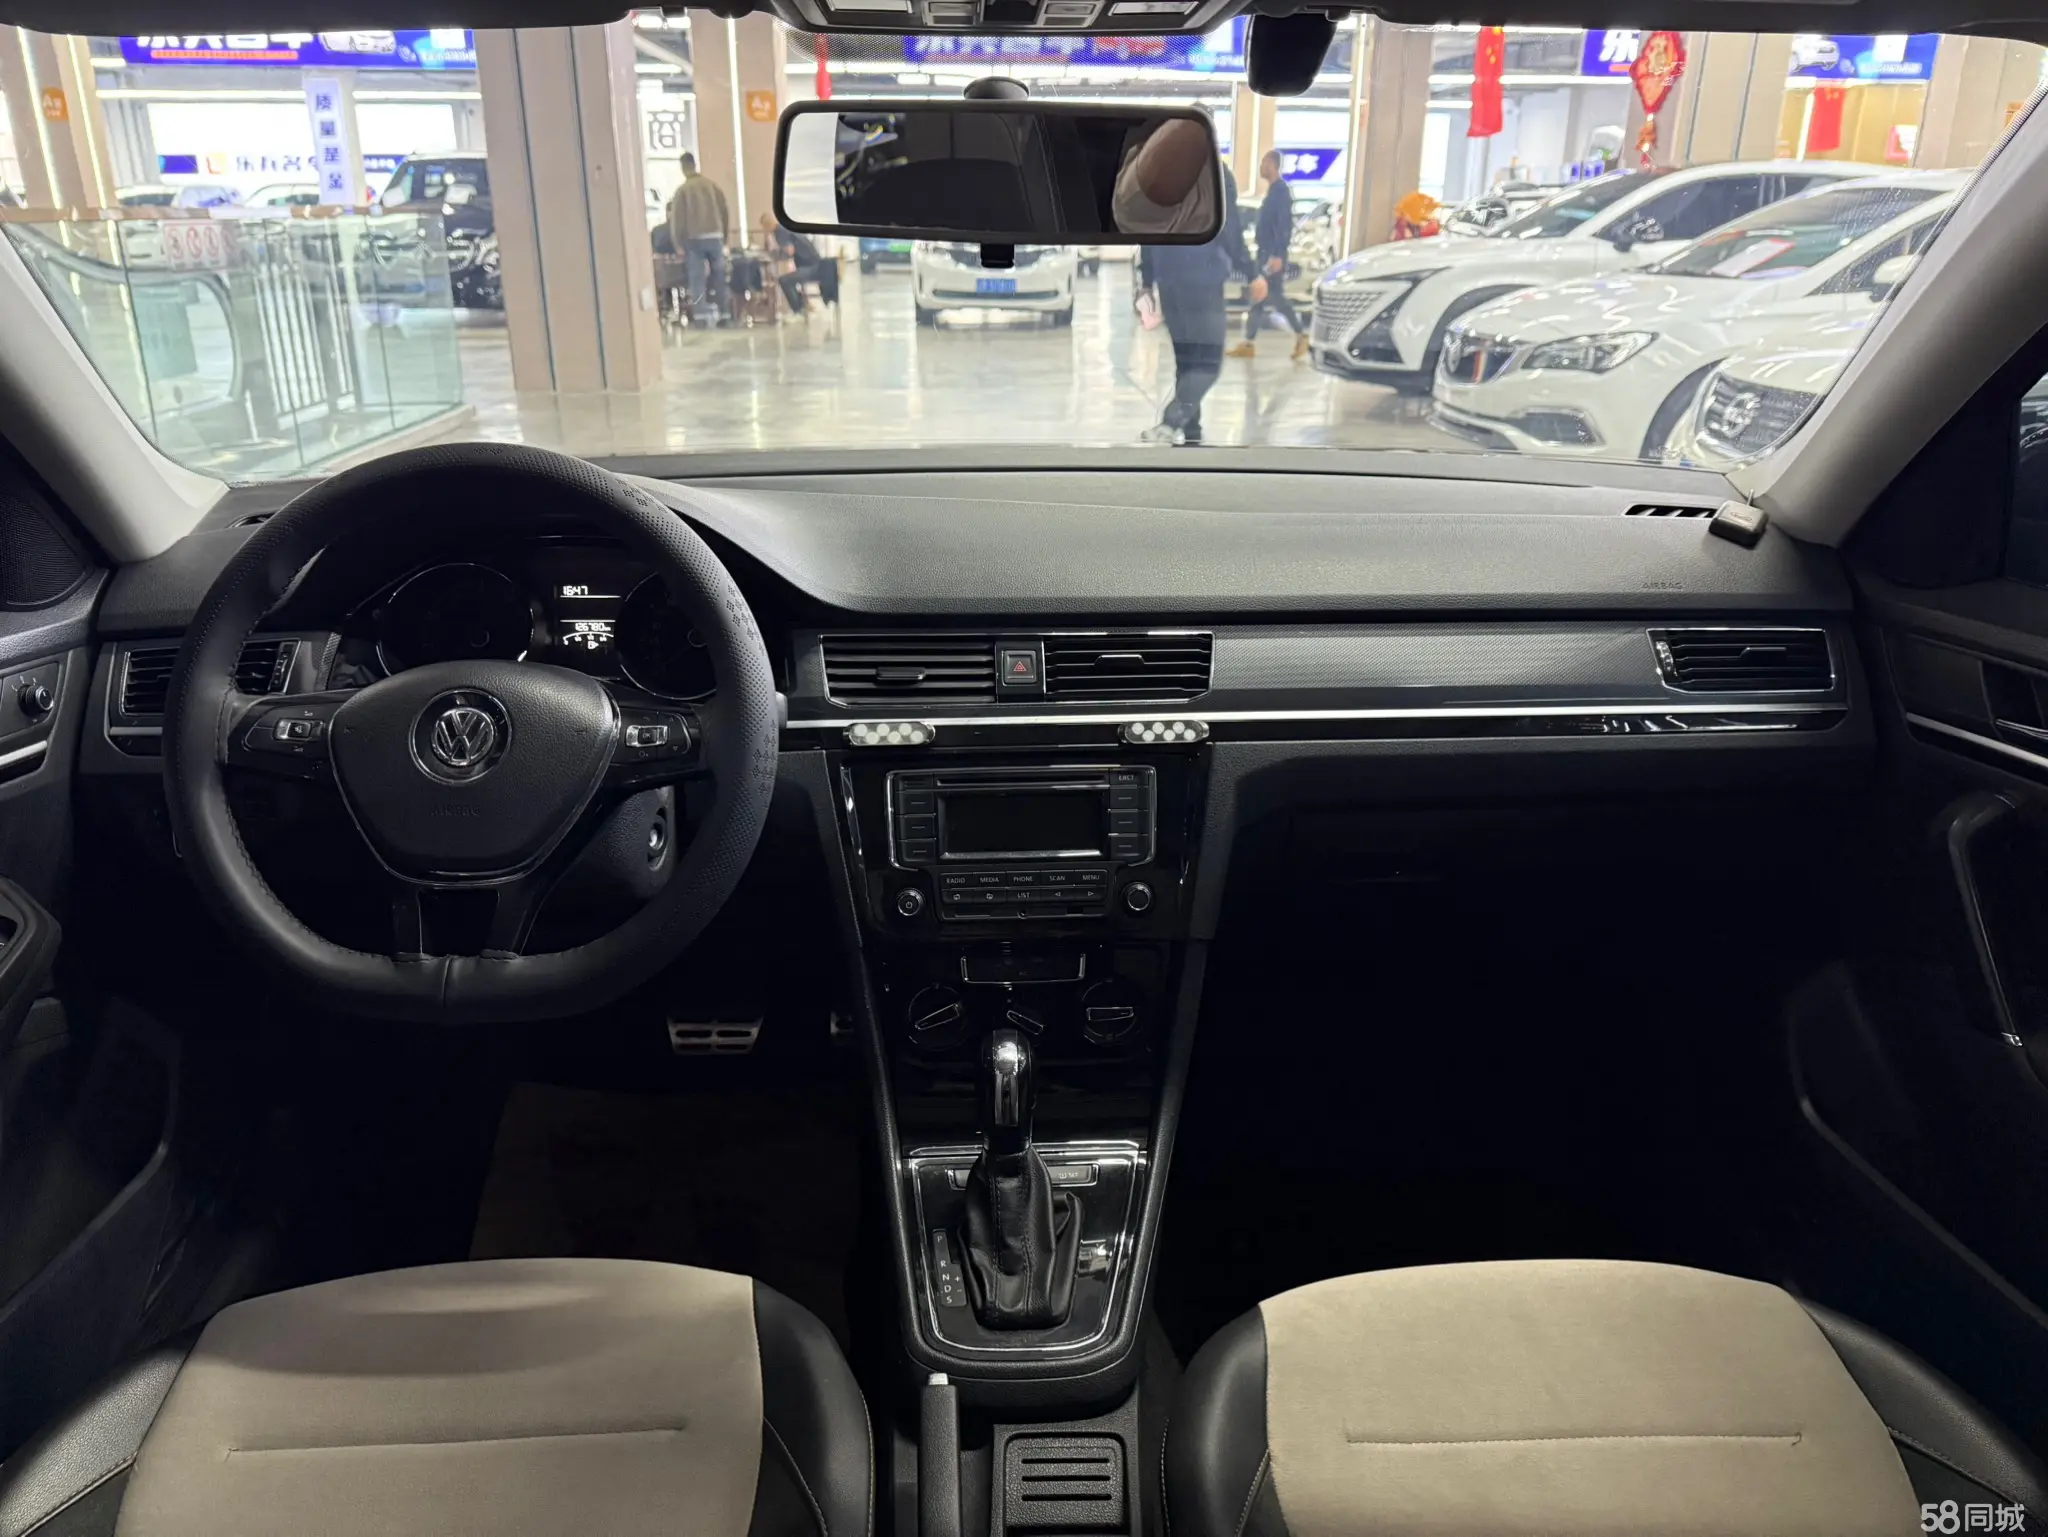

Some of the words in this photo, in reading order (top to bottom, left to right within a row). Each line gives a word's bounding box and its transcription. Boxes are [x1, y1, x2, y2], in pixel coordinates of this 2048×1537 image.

[940, 1260, 947, 1268] R
[942, 1273, 950, 1281] N
[944, 1284, 952, 1293] D
[946, 1295, 953, 1304] S
